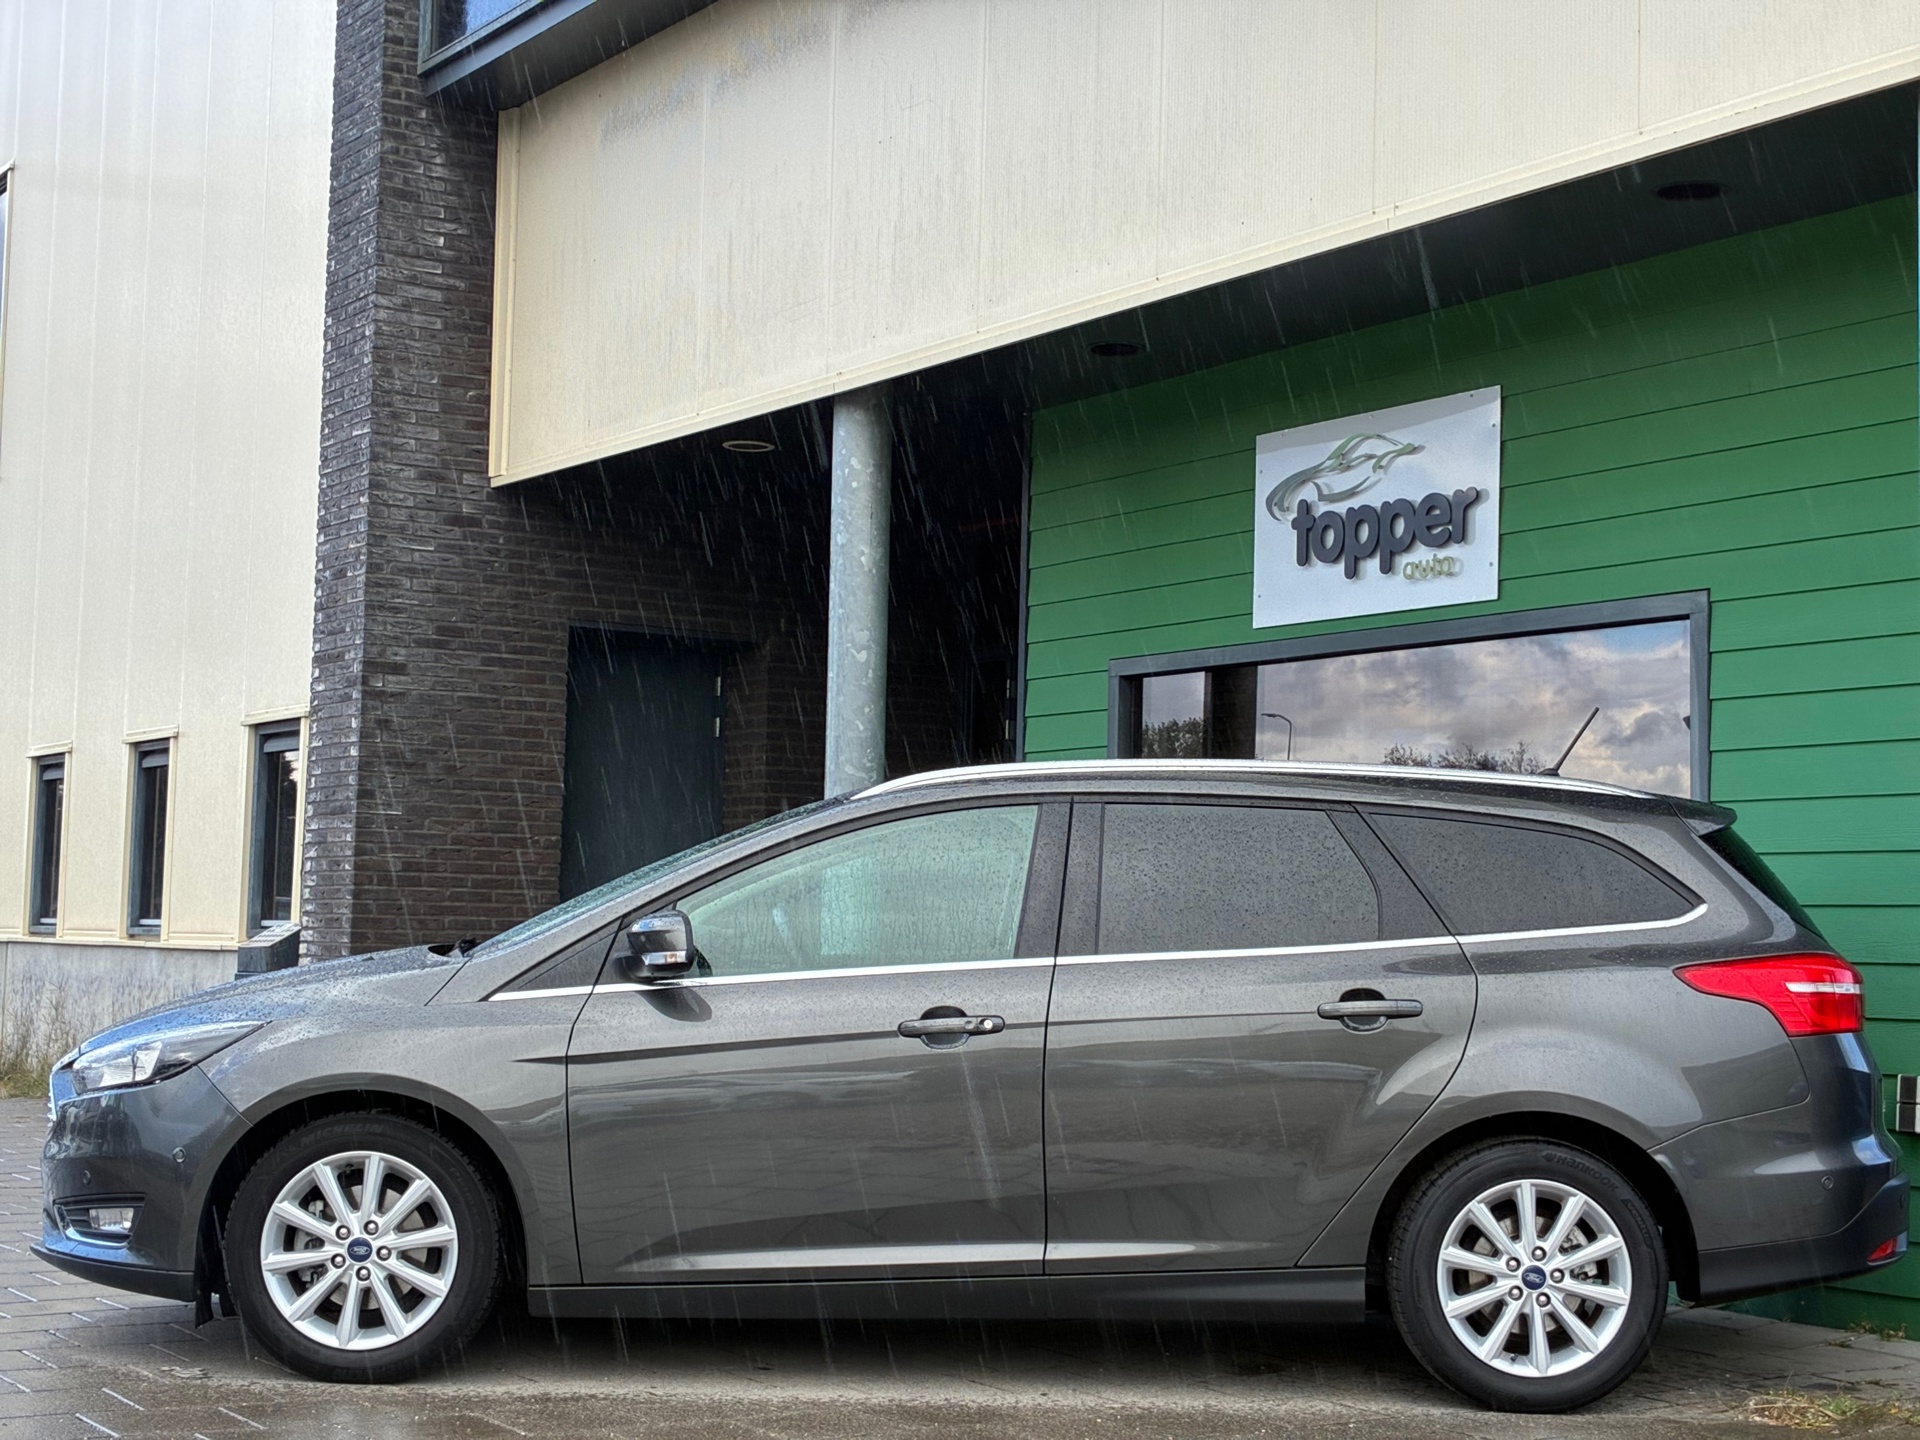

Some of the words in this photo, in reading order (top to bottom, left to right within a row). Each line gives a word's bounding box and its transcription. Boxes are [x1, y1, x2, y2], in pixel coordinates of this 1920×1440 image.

[1291, 486, 1479, 580] topper
[1402, 553, 1456, 580] auto
[300, 1123, 385, 1146] MICHELIN
